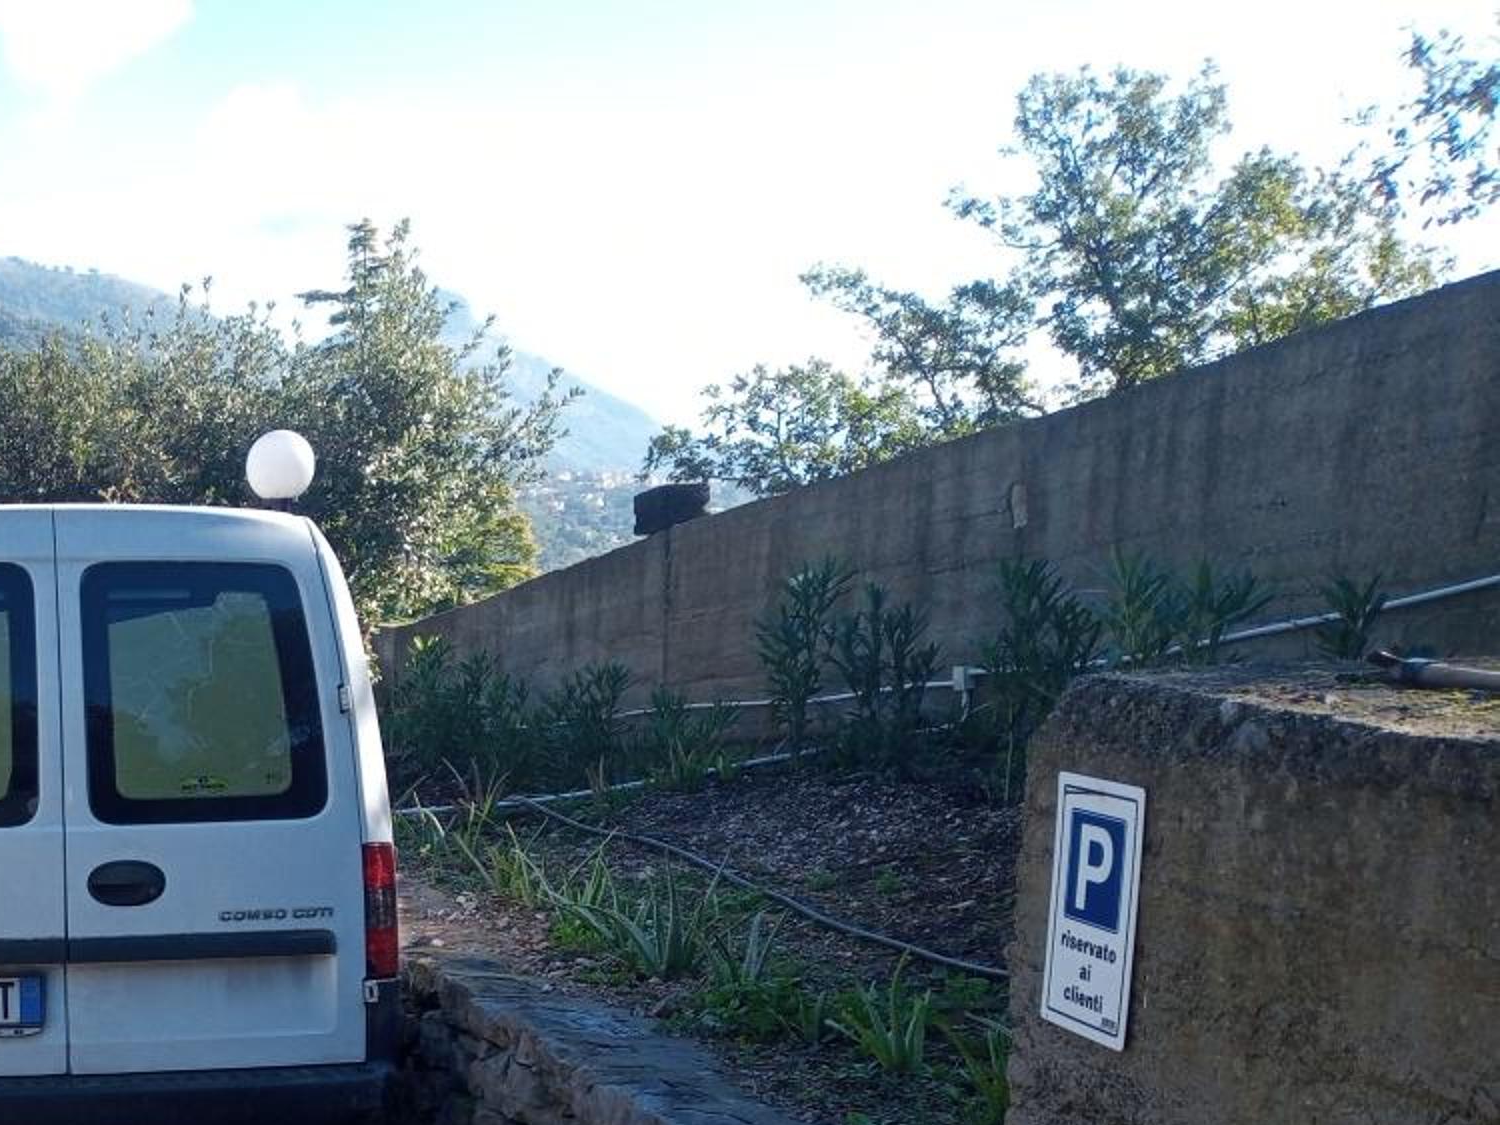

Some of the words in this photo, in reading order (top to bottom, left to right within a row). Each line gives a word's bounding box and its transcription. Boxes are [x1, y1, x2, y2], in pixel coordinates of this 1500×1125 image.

[1075, 822, 1114, 911] P
[1060, 929, 1117, 964] riservato
[1078, 964, 1093, 982] ai
[1063, 984, 1104, 1014] clienti
